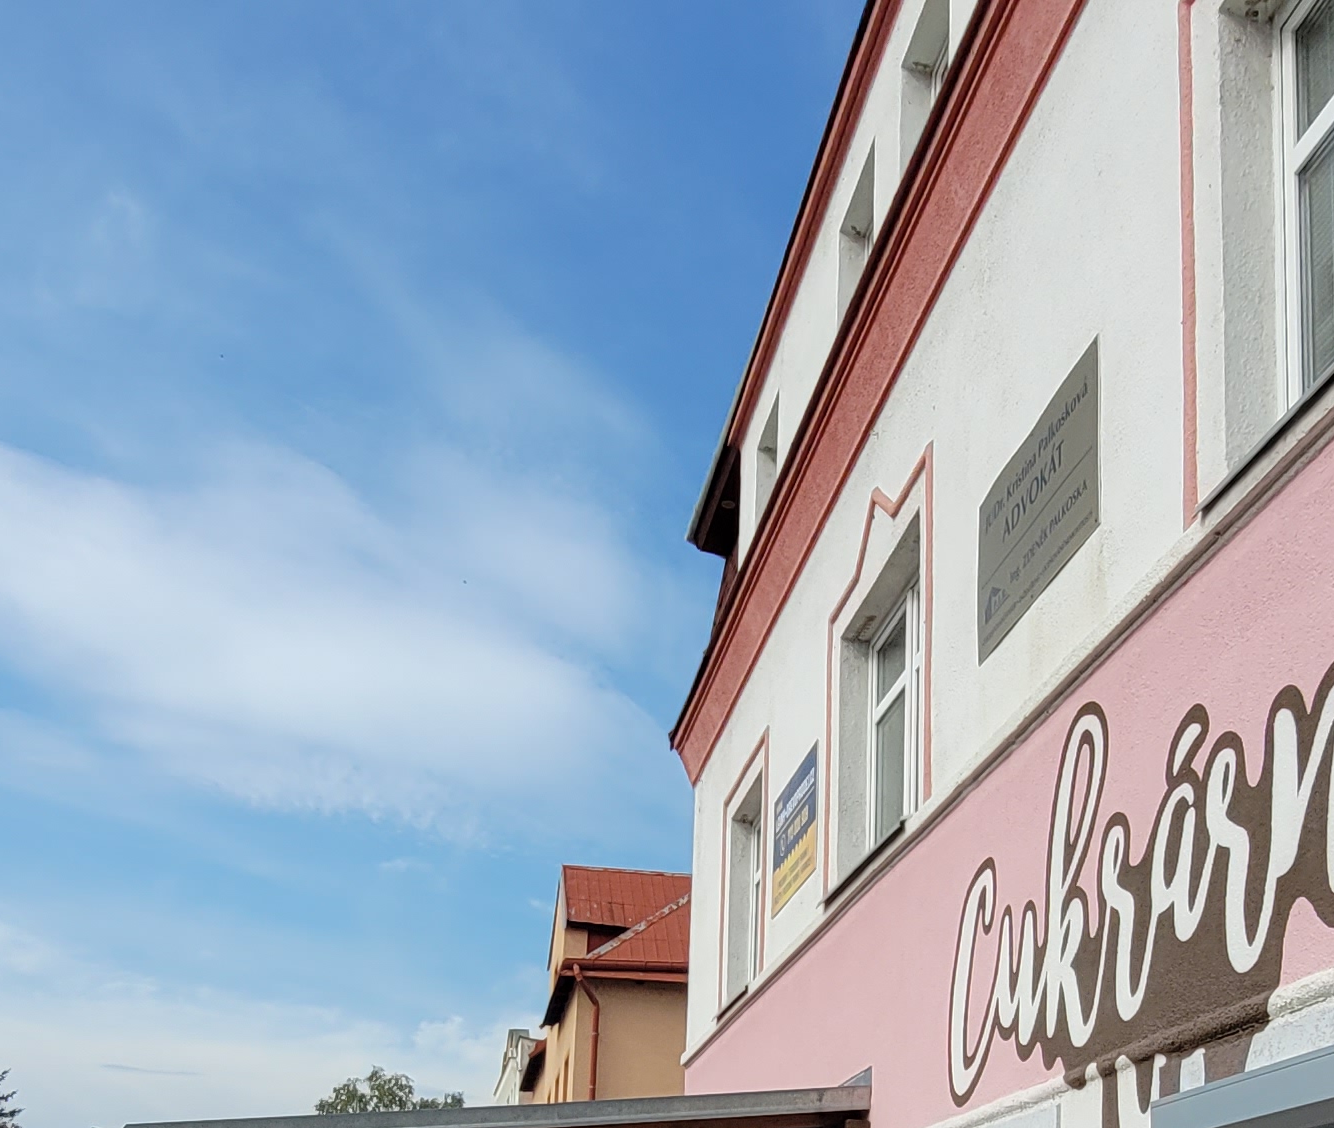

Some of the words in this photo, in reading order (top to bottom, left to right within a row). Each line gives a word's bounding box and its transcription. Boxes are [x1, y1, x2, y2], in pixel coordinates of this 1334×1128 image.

[1006, 453, 1037, 499] Kristina
[1037, 376, 1089, 459] Palkosková
[1002, 440, 1065, 544] ADVOKÁT
[1048, 479, 1088, 535] PALKOSKA
